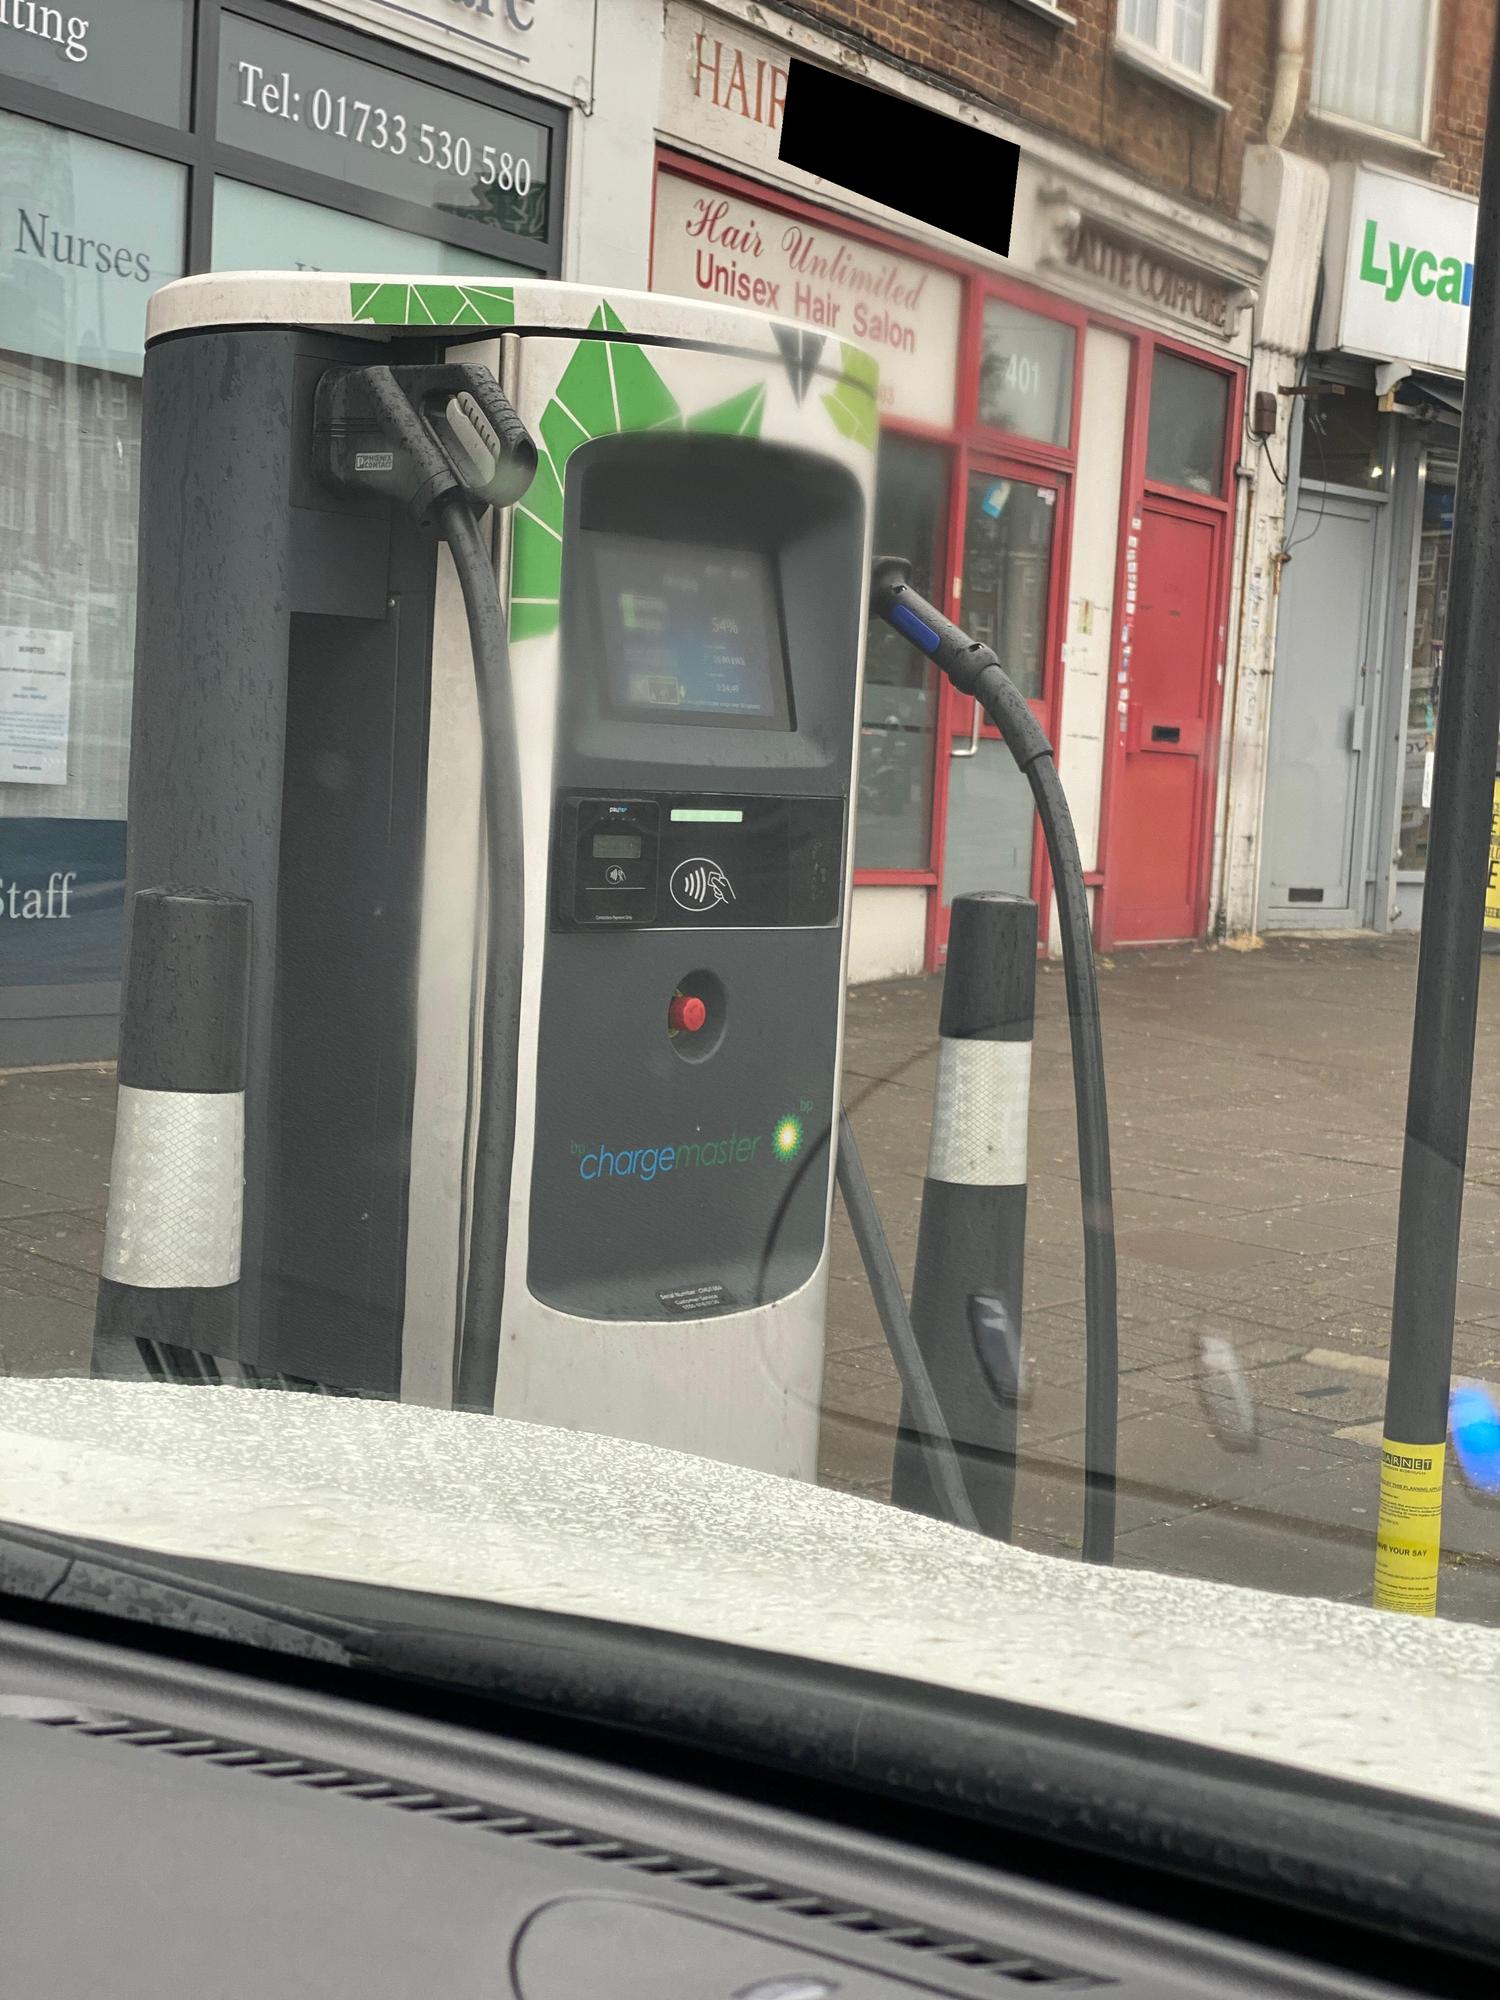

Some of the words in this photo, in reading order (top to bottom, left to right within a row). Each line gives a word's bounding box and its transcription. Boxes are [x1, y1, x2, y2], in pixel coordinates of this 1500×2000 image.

[238, 61, 301, 122] Tel:
[311, 88, 407, 155] 01733
[418, 123, 473, 177] 530
[480, 146, 533, 197] 580
[14, 208, 152, 283] Nurses
[685, 198, 765, 258] Hair
[780, 225, 930, 312] Unlimited
[694, 249, 780, 310] Unisex
[793, 281, 841, 329] Hair
[852, 302, 916, 354] Salon
[1004, 352, 1041, 396] 401
[578, 1131, 763, 1182] chargemaster
[1383, 1452, 1432, 1470] ARNET
[1389, 1545, 1410, 1556] YOUR
[1411, 1549, 1428, 1557] SAY
